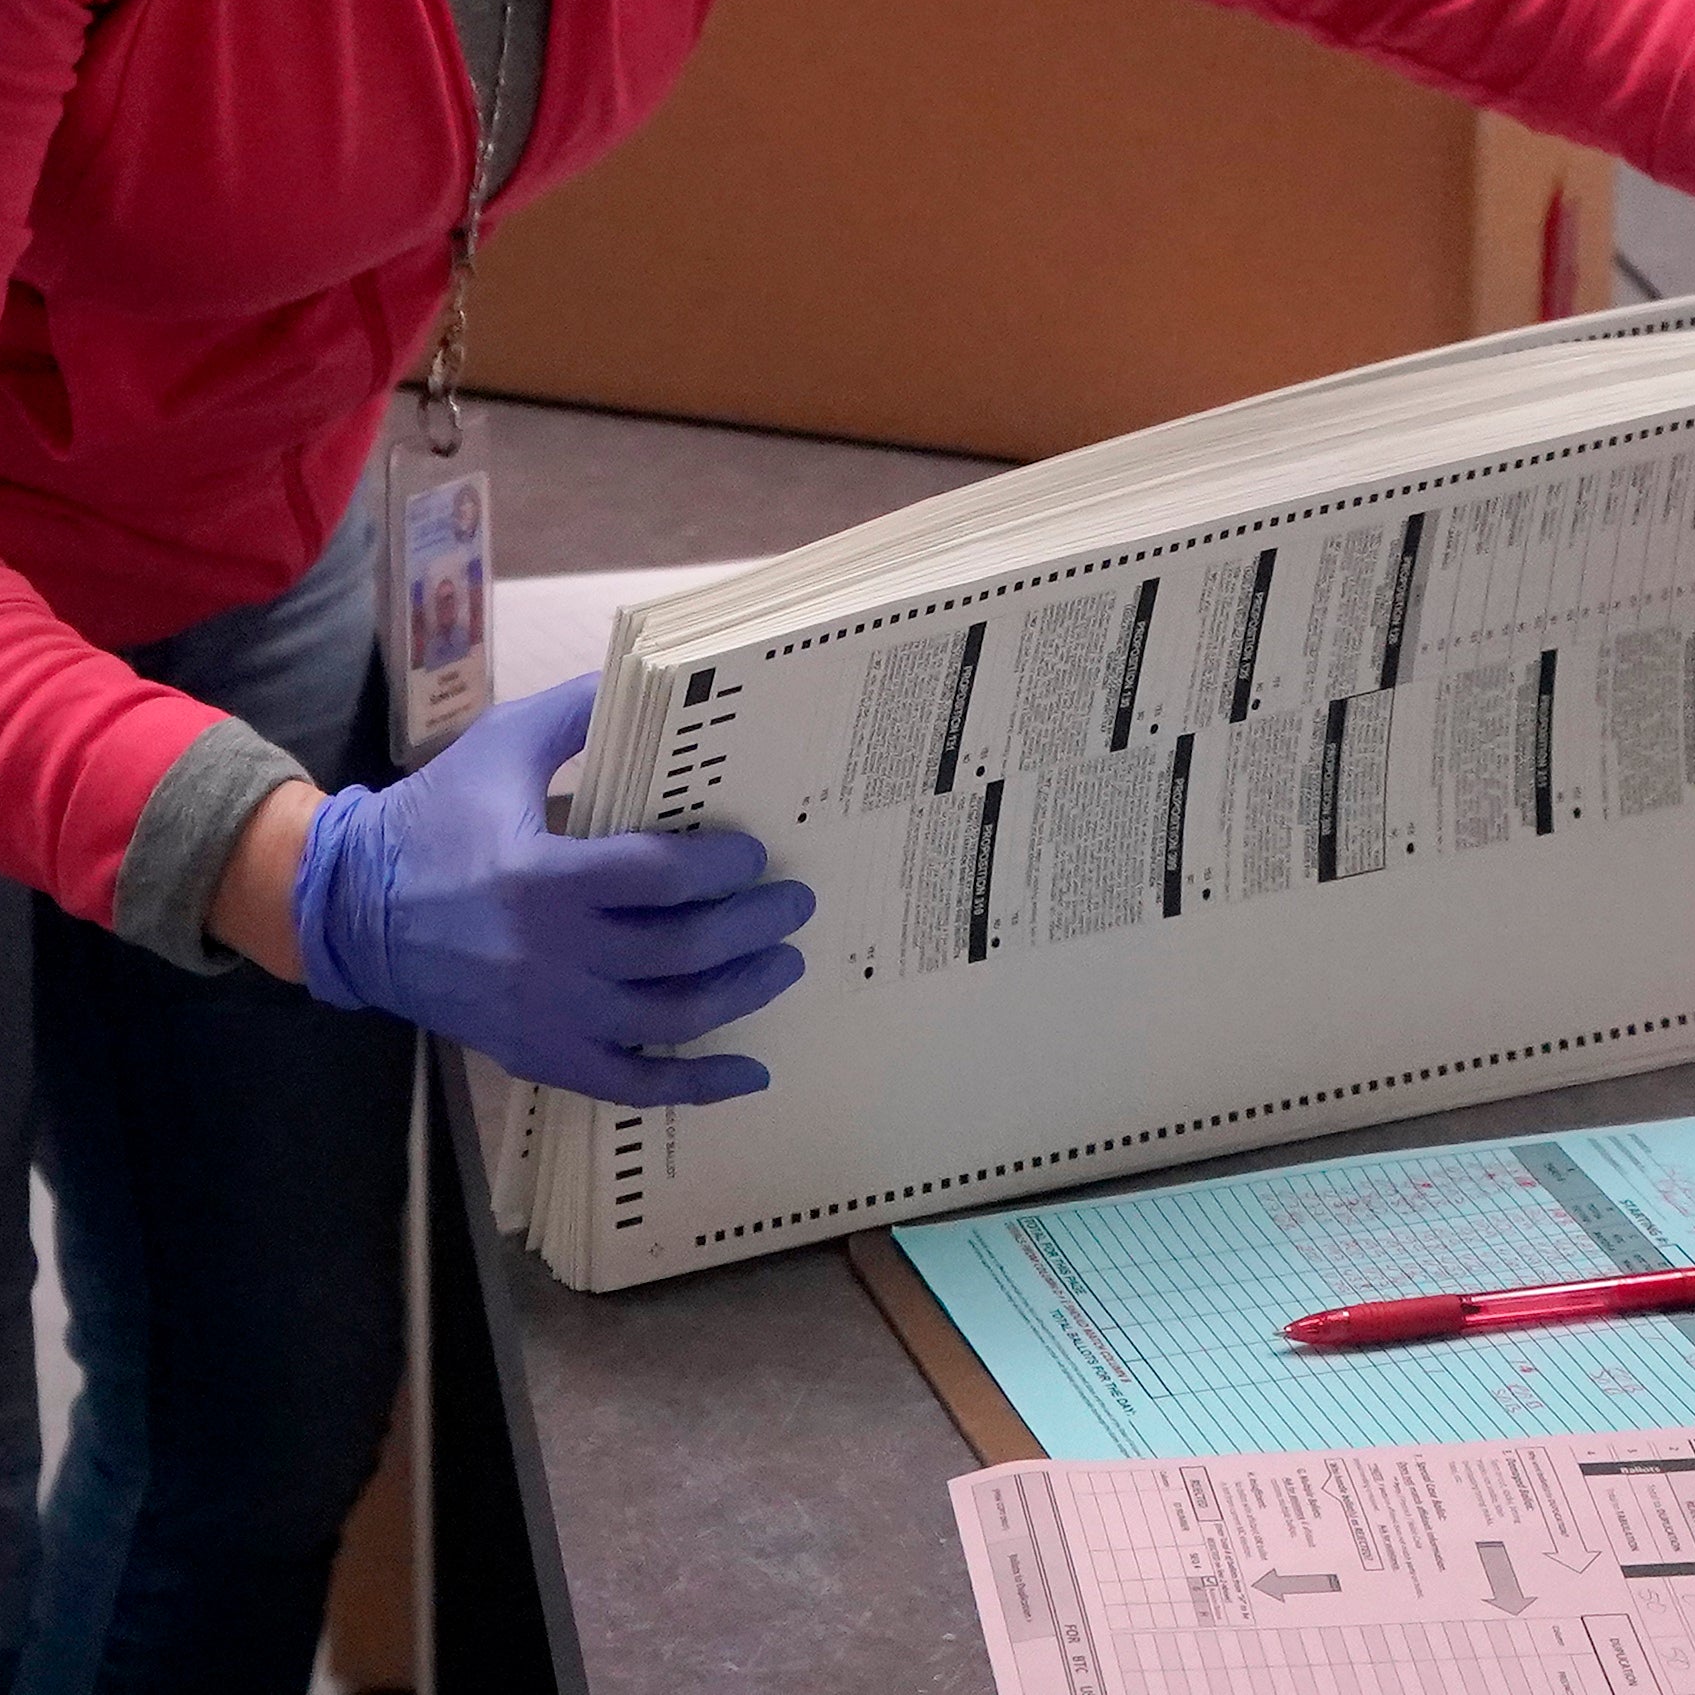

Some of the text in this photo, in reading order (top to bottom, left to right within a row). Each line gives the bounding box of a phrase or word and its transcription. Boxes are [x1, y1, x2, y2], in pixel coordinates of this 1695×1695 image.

[1241, 591, 1263, 662] PROPOSITION
[1122, 620, 1145, 690] PROPOSITION
[949, 665, 972, 732] PROPOSITION
[1166, 777, 1184, 851] PROPOSITION
[975, 823, 992, 895] PROPOSITION
[665, 1141, 675, 1179] BALLOT
[1618, 1199, 1664, 1236] STARTING
[1022, 1218, 1088, 1295] TOTAL FOR THIS PAGE
[1047, 1308, 1140, 1416] TOTAL BALLOTS FOR THE DAY:
[1062, 1304, 1090, 1328] SHOULD
[1079, 1327, 1107, 1350] MATCH
[1097, 1350, 1128, 1378] COLUMN
[1416, 1461, 1448, 1521] Special Case Ballot:
[1504, 1458, 1535, 1511] Damaged Ballot:
[1616, 1464, 1663, 1474] Ballots
[1190, 1479, 1208, 1509] REJECTED
[1396, 1461, 1448, 1572] Does not match affidavit information.
[1174, 1508, 1190, 1531] NUMBER
[1352, 1527, 1372, 1561] REJECTED?
[1611, 1510, 1643, 1551] TABULATION
[1653, 1509, 1686, 1552] DUPLICATION
[1188, 1552, 1200, 1562] SEQ
[1014, 1583, 1032, 1617] Duplication
[1064, 1624, 1086, 1673] FOR BTC
[1608, 1638, 1640, 1686] DUPLICATION
